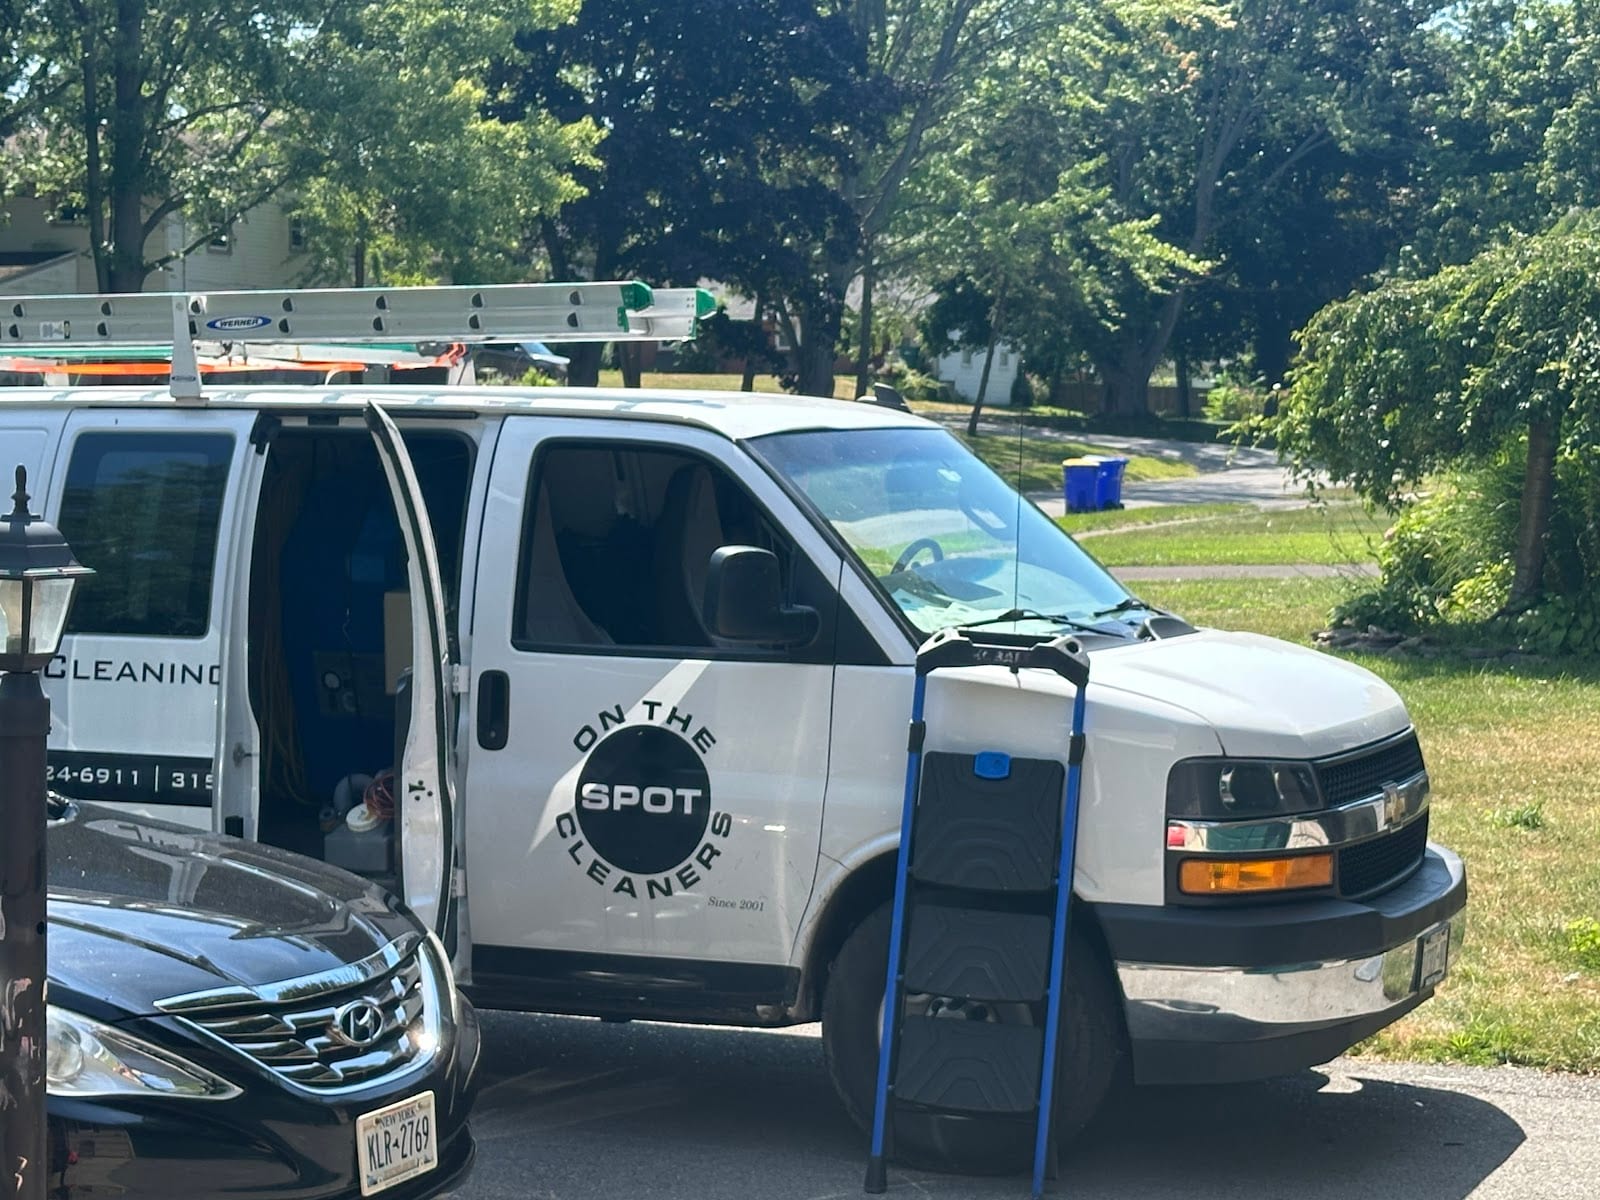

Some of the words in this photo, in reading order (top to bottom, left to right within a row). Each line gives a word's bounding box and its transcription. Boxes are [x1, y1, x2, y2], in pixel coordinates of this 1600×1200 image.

[219, 318, 259, 328] WERNER
[573, 704, 626, 753] ON
[642, 700, 717, 754] THE
[581, 782, 702, 815] SPOT
[555, 811, 732, 899] CLEANERS
[708, 896, 737, 909] Since
[739, 900, 764, 911] 2001
[380, 1112, 397, 1129] NEW
[397, 1108, 416, 1120] YORK
